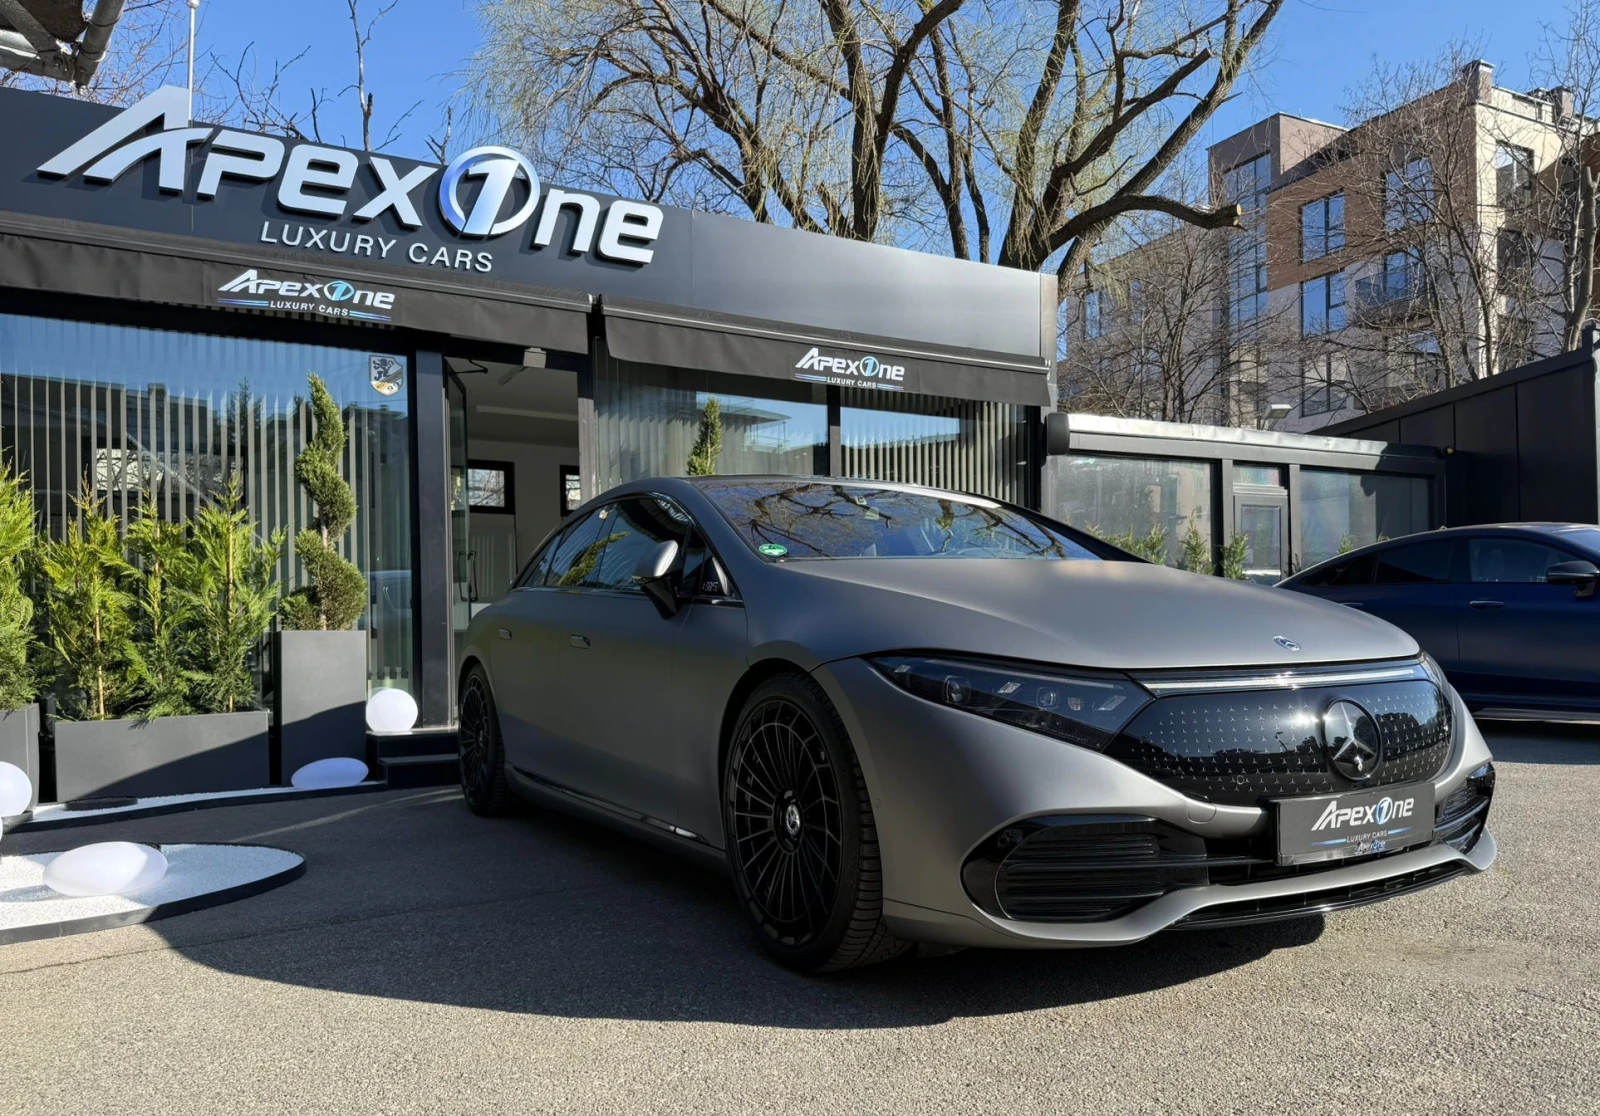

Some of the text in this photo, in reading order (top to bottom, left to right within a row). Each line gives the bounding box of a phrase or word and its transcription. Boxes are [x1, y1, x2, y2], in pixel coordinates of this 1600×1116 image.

[260, 221, 494, 273] LUXURY CARS
[270, 300, 348, 317] LUXURY CARS
[827, 376, 877, 389] LUXURY CARS
[1346, 830, 1387, 843] LUXURY CARS
